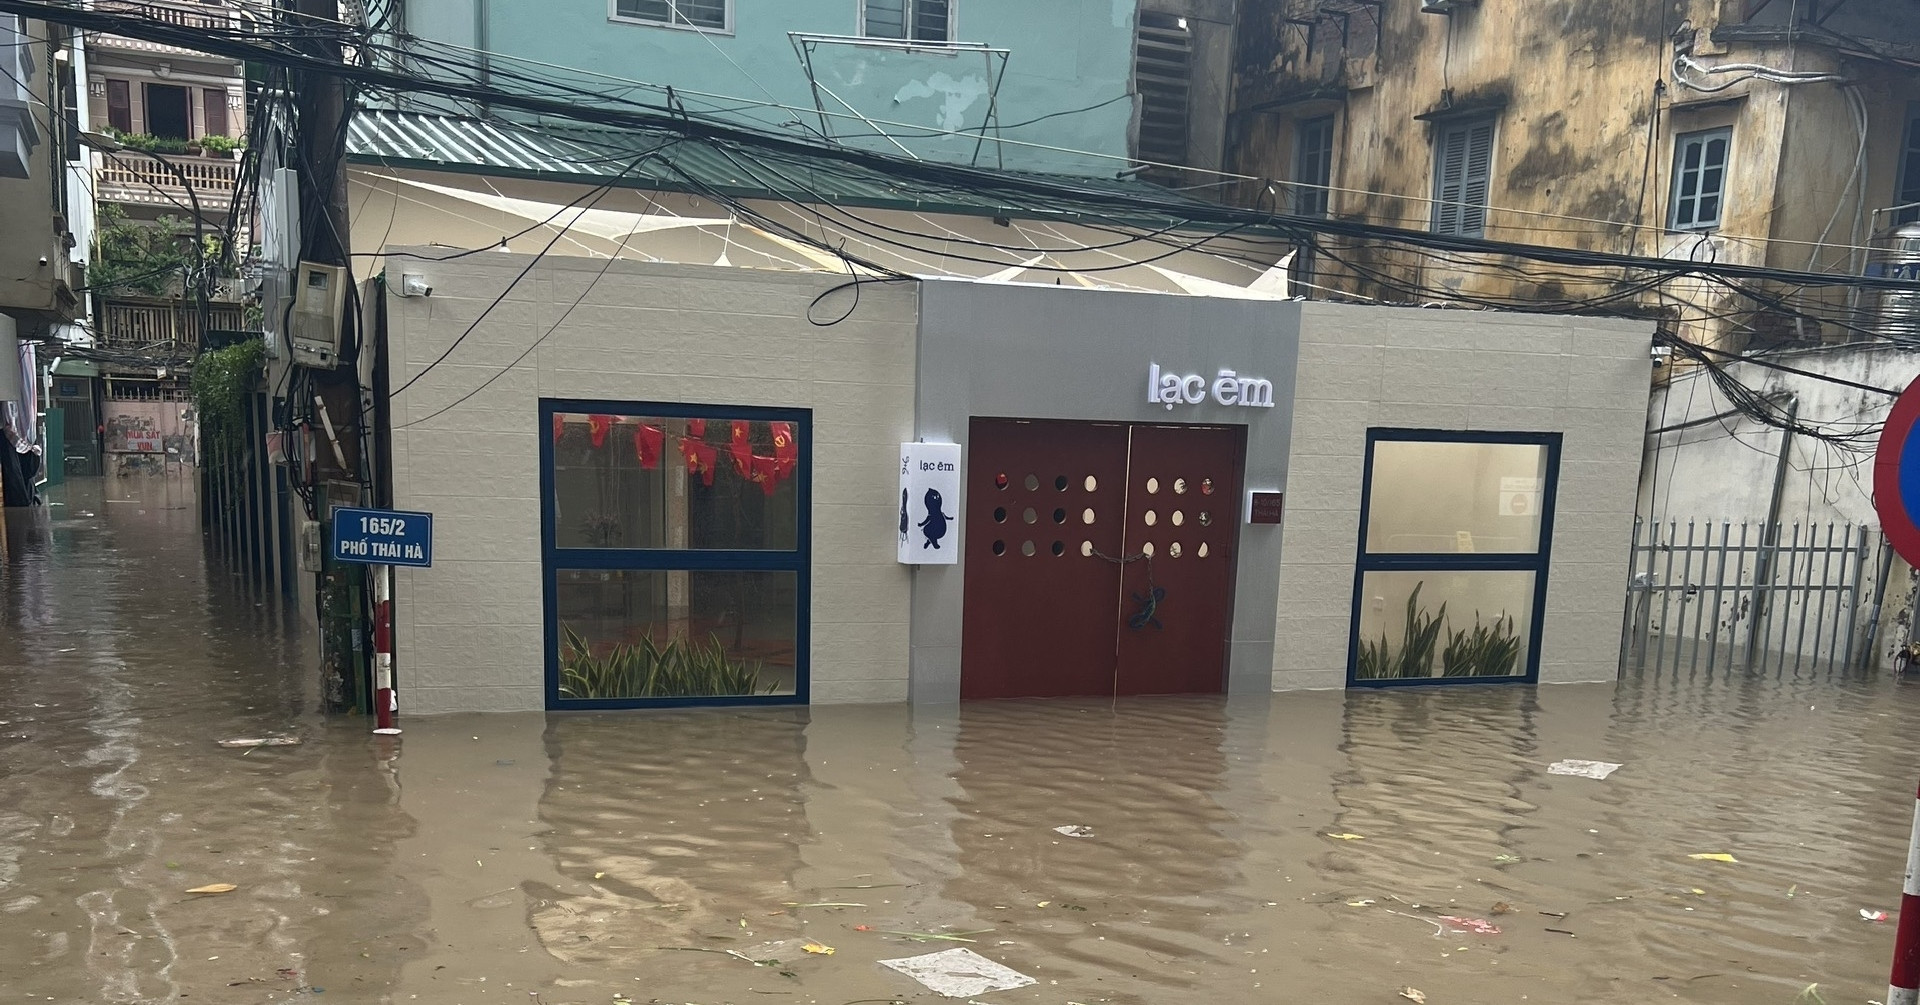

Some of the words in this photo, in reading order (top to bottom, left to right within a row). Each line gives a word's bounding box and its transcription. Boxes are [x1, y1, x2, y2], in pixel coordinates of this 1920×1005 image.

[1148, 361, 1206, 410] lạc
[1212, 370, 1275, 407] ēm
[919, 460, 935, 472] lạc
[360, 517, 405, 536] 165/2
[340, 538, 368, 556] PHỐ
[371, 541, 401, 558] THÁI
[404, 543, 423, 559] HÀ
